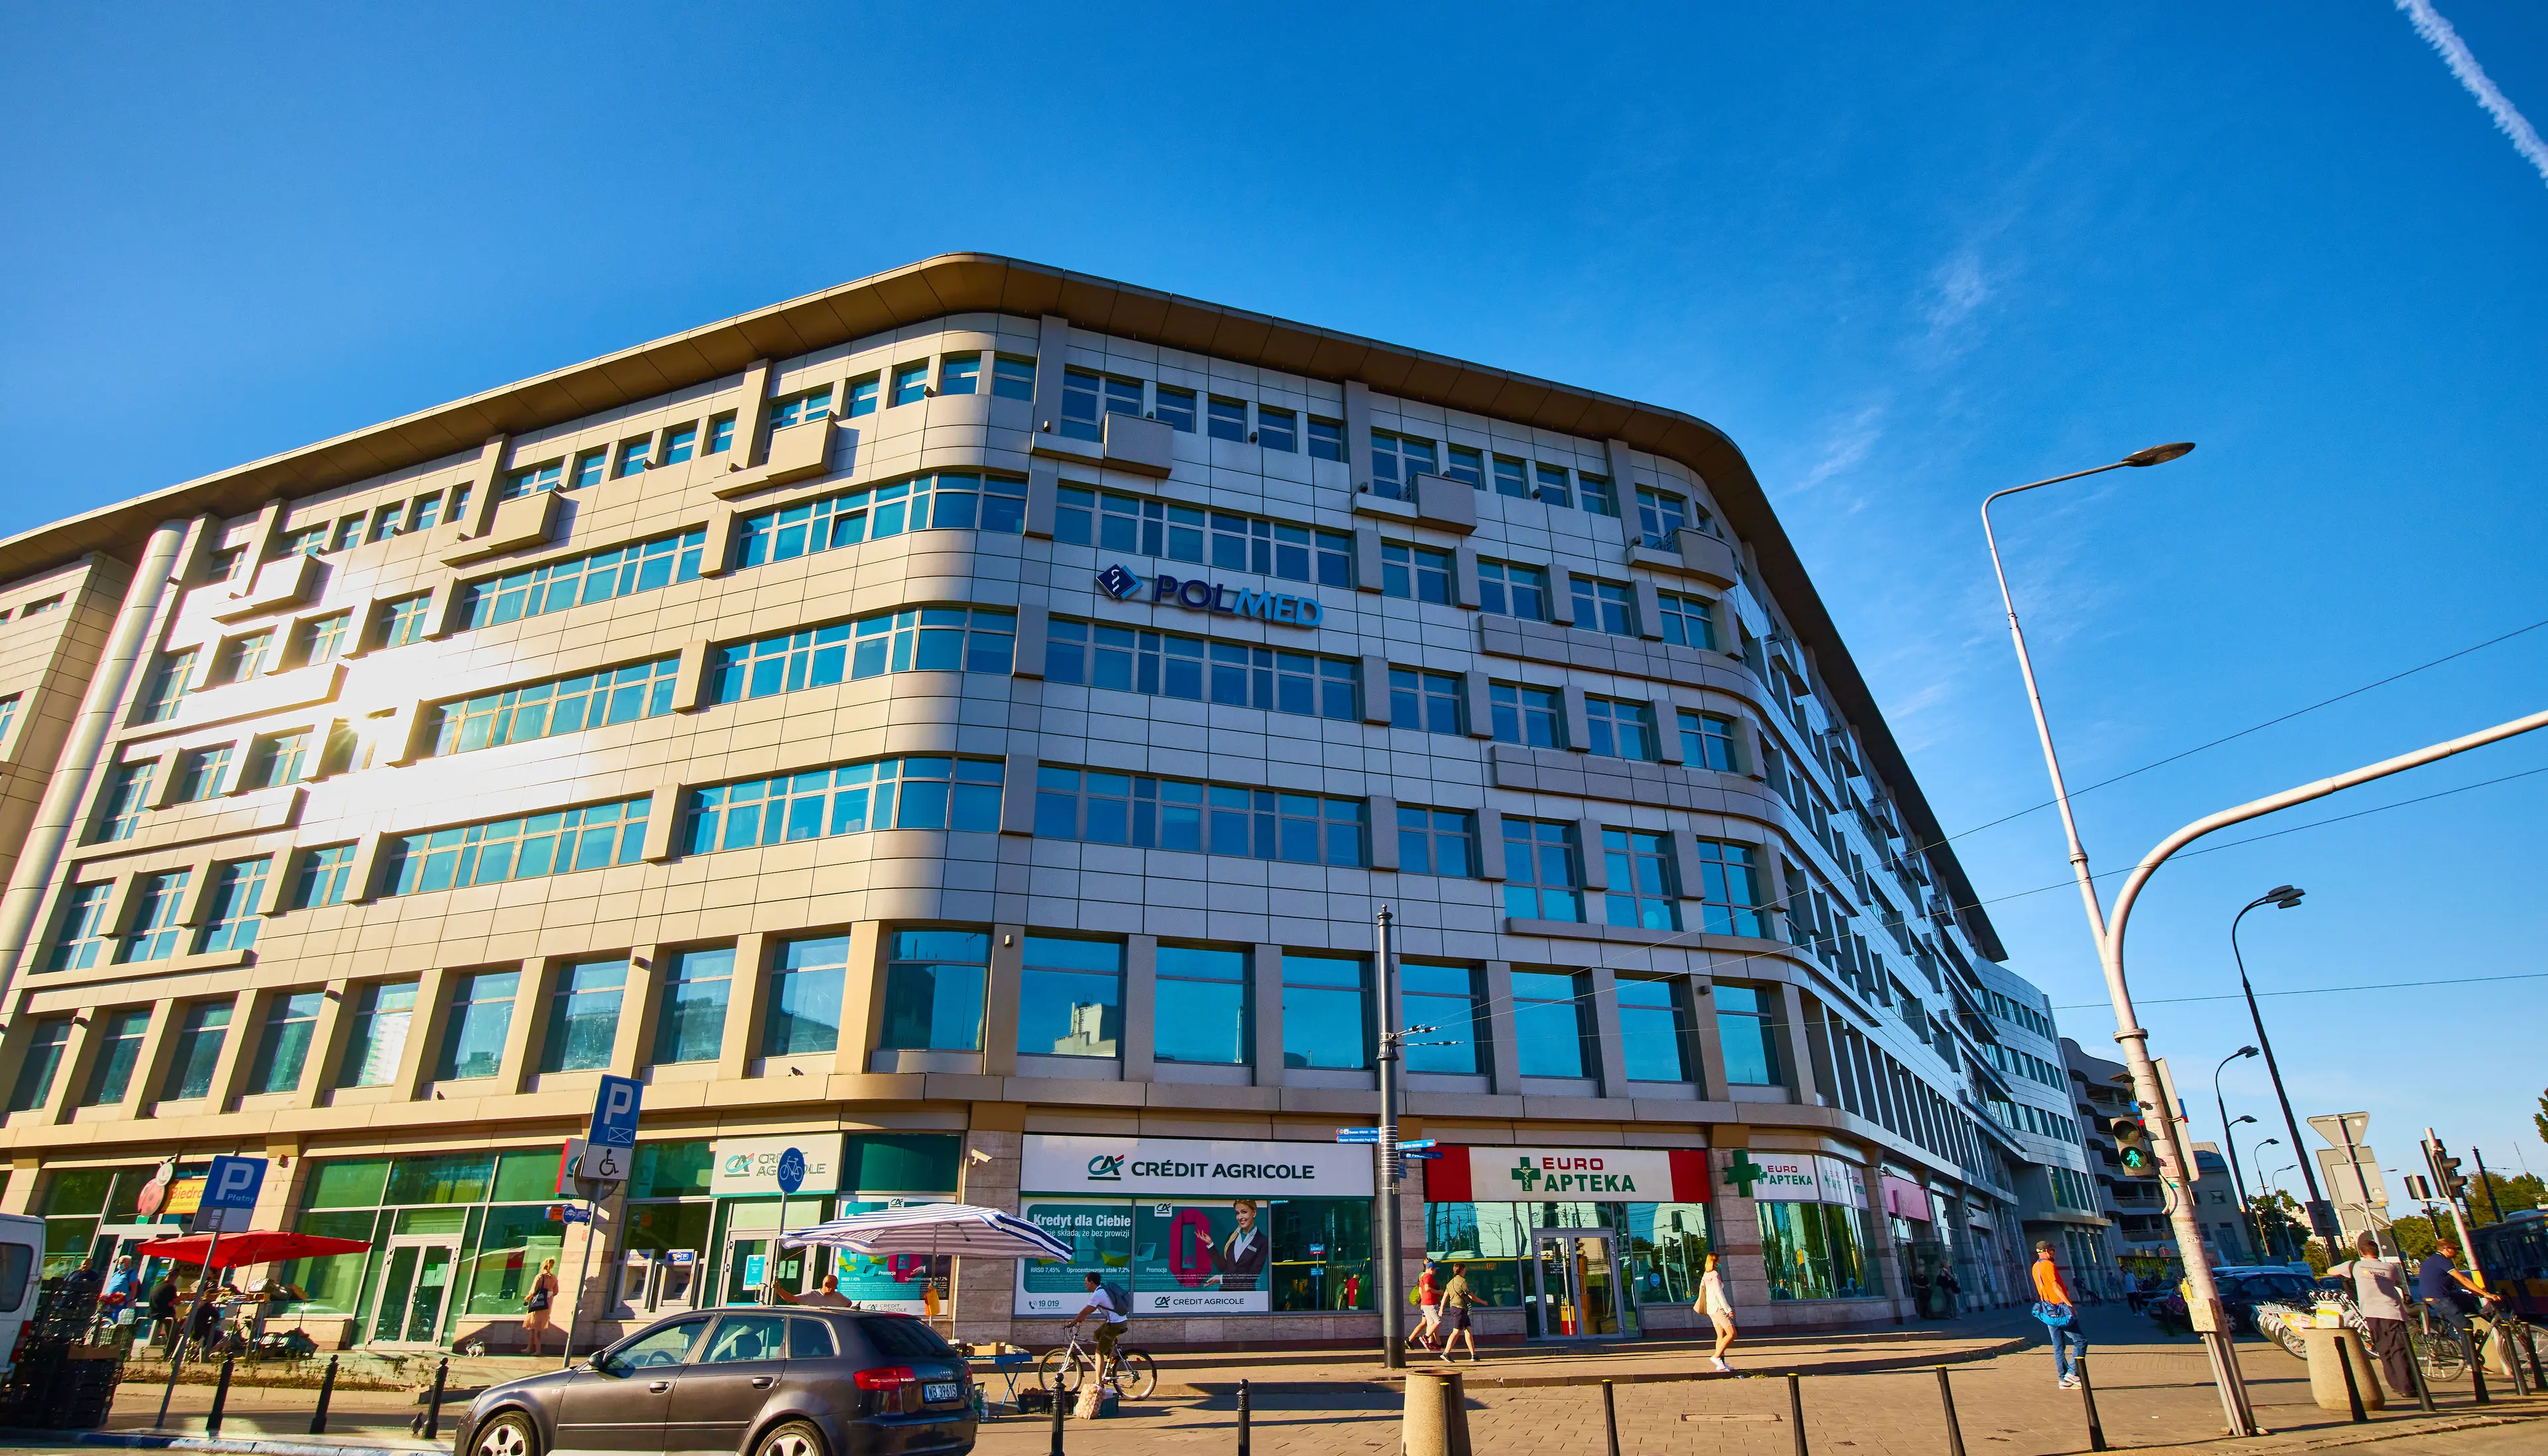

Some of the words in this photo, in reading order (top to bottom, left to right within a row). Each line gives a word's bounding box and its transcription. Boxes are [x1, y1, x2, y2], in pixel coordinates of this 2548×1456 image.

[1154, 574, 1324, 627] POLMED
[603, 1083, 634, 1124] P
[1131, 1159, 1209, 1177] CRÉDIT
[1212, 1163, 1315, 1179] AGRICOLE
[1542, 1157, 1604, 1171] EURO
[216, 1162, 254, 1200] P
[1544, 1174, 1637, 1192] APTEKA
[1769, 1175, 1813, 1185] APTEKA
[227, 1194, 255, 1205] Płatny
[1033, 1214, 1072, 1228] Kredyt
[1075, 1215, 1092, 1226] dla
[1096, 1215, 1131, 1226] Ciebie
[1057, 1229, 1081, 1238] składa,
[1104, 1230, 1129, 1238] prowizji
[928, 1385, 938, 1399] WB
[938, 1384, 956, 1397] 3961S
